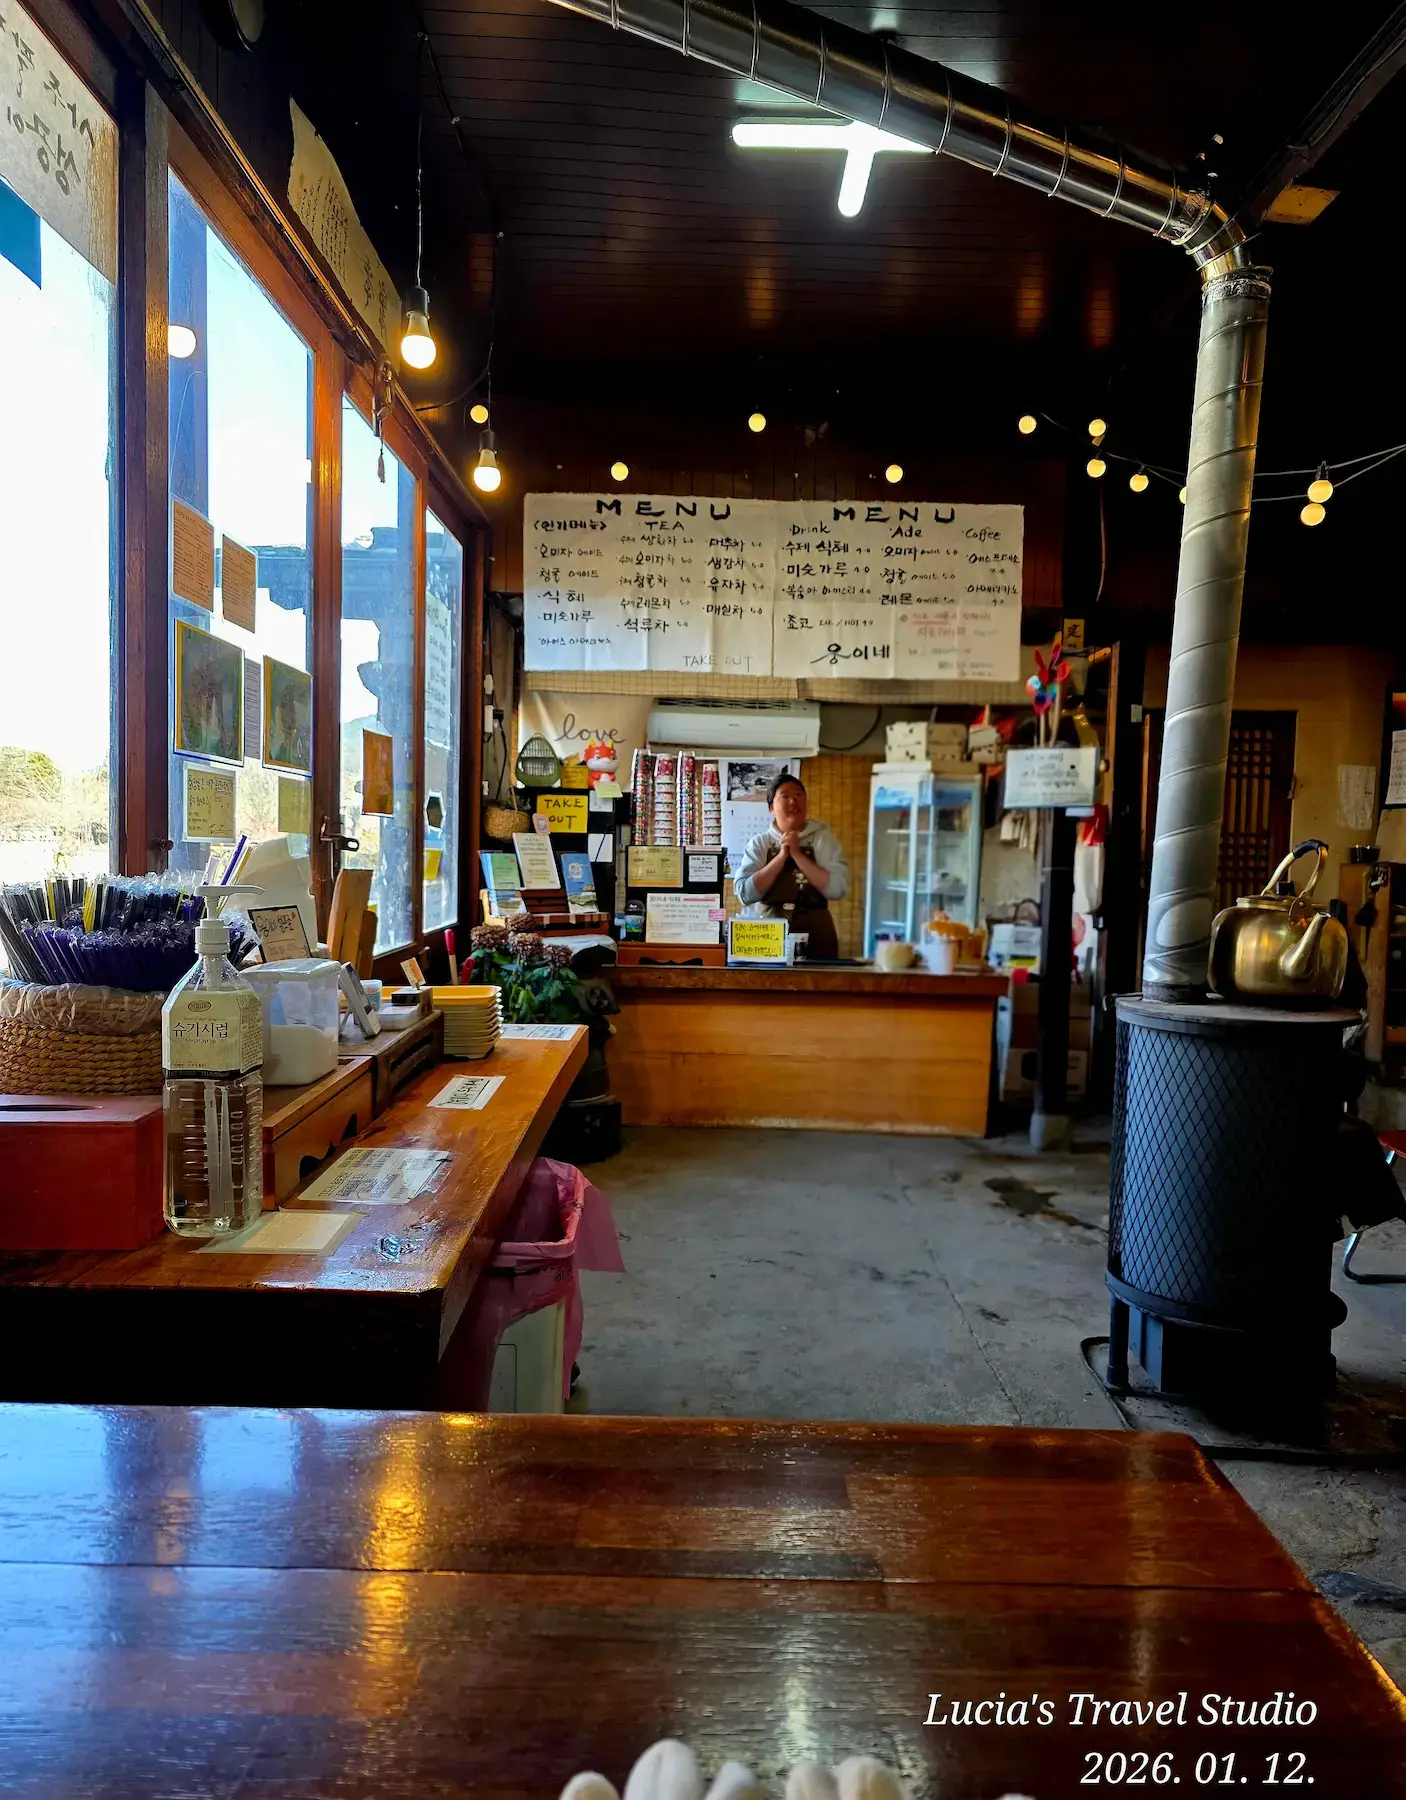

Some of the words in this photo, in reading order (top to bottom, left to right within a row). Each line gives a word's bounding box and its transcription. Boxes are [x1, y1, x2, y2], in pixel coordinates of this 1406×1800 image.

[596, 499, 731, 520] MENU
[833, 506, 956, 523] MENU
[645, 521, 684, 531] TEA
[792, 520, 831, 536] Drink
[891, 526, 923, 538] Ade
[966, 527, 1001, 542] Coffee
[540, 543, 573, 558] 오미자
[785, 541, 810, 556] 수제
[884, 546, 917, 562] 오미자
[708, 556, 746, 570] 생강차
[787, 562, 848, 577] 미숫가루
[568, 570, 599, 578] 에이드
[708, 577, 747, 595] 유자차
[787, 584, 818, 600] 복숭아
[881, 593, 913, 605] 레몬
[624, 618, 670, 634] 석류차
[684, 655, 717, 667] TAKE
[725, 655, 754, 672] OUT
[555, 713, 626, 744] love
[544, 799, 584, 809] TAKE
[549, 815, 577, 830] OUT
[172, 1022, 228, 1038] 슈가시럽
